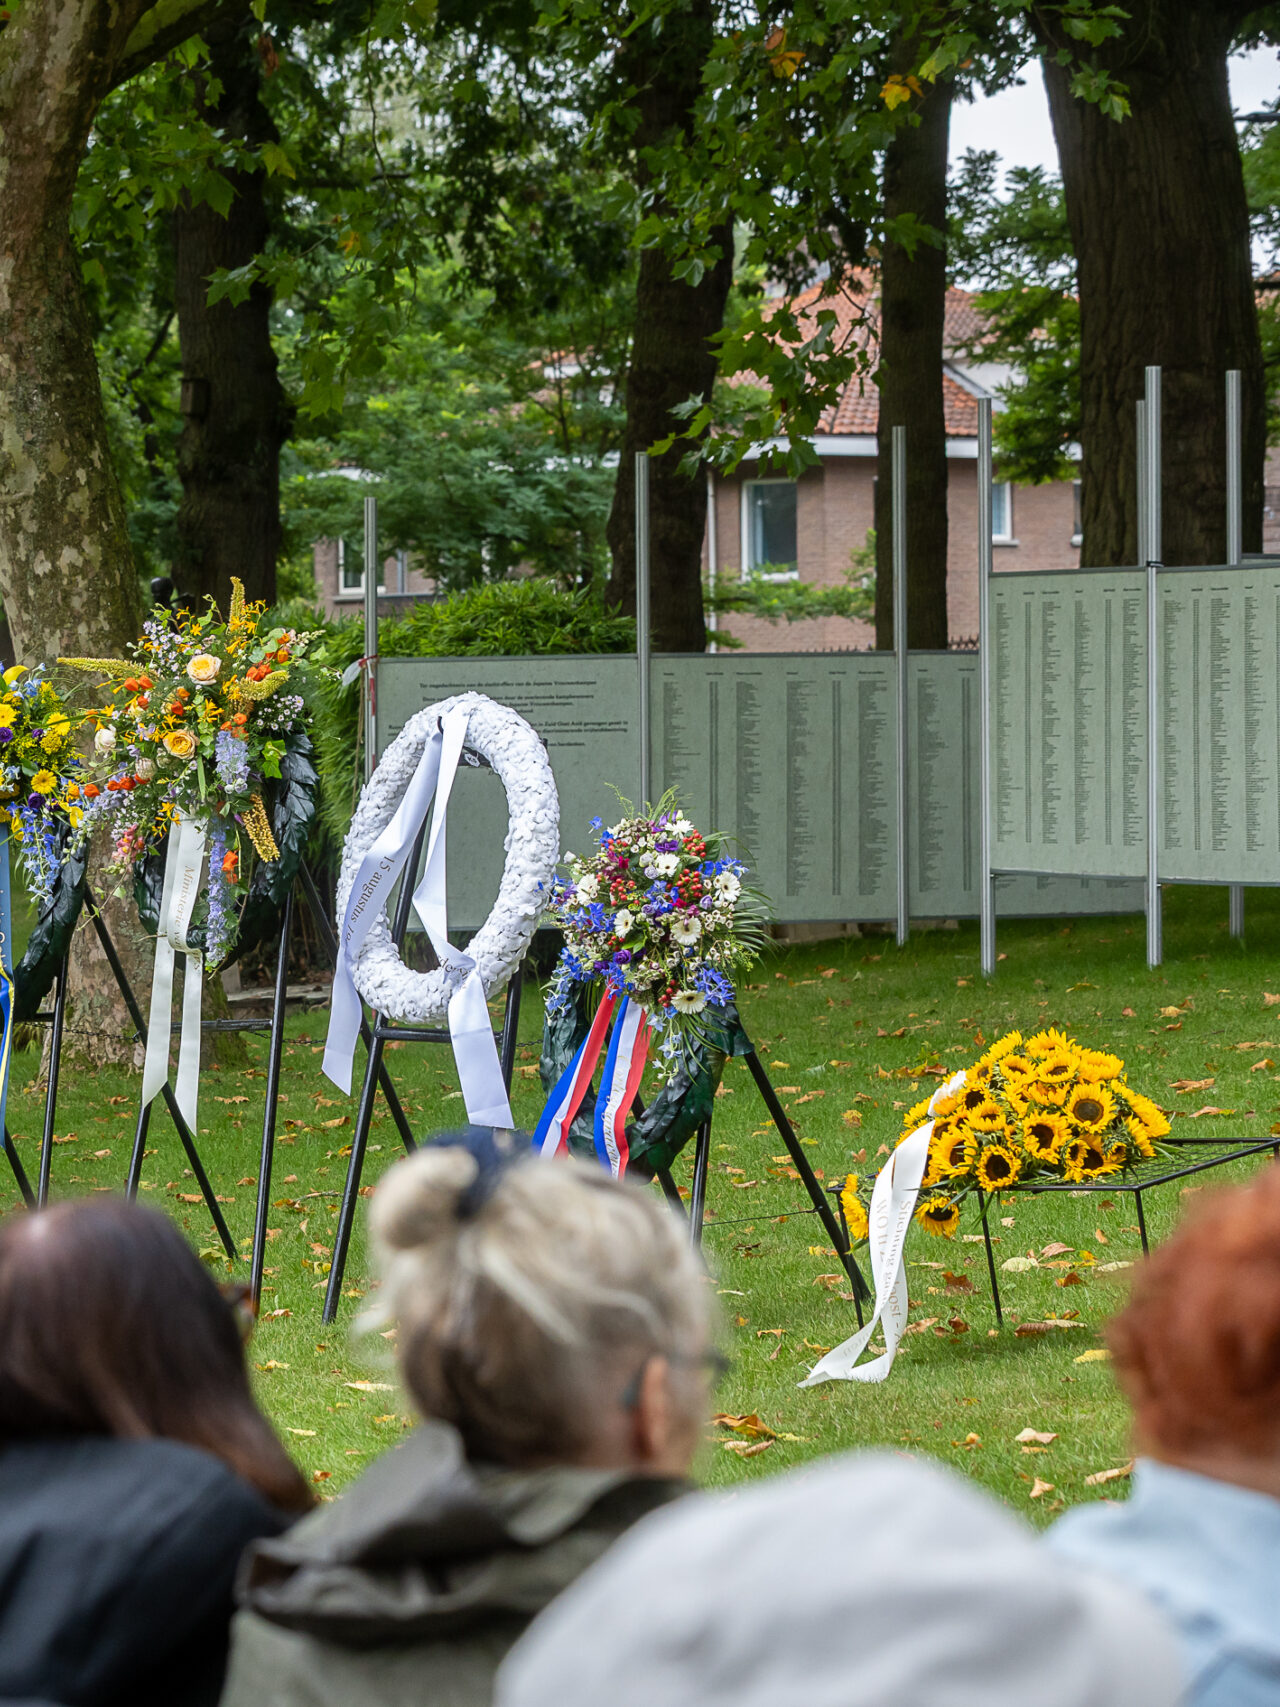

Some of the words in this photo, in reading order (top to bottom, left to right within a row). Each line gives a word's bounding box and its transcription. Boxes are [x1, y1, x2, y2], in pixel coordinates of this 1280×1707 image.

[379, 856, 396, 873] 15
[175, 865, 196, 928] Ministerie
[351, 872, 383, 923] augustus
[884, 1200, 912, 1268] Stichting
